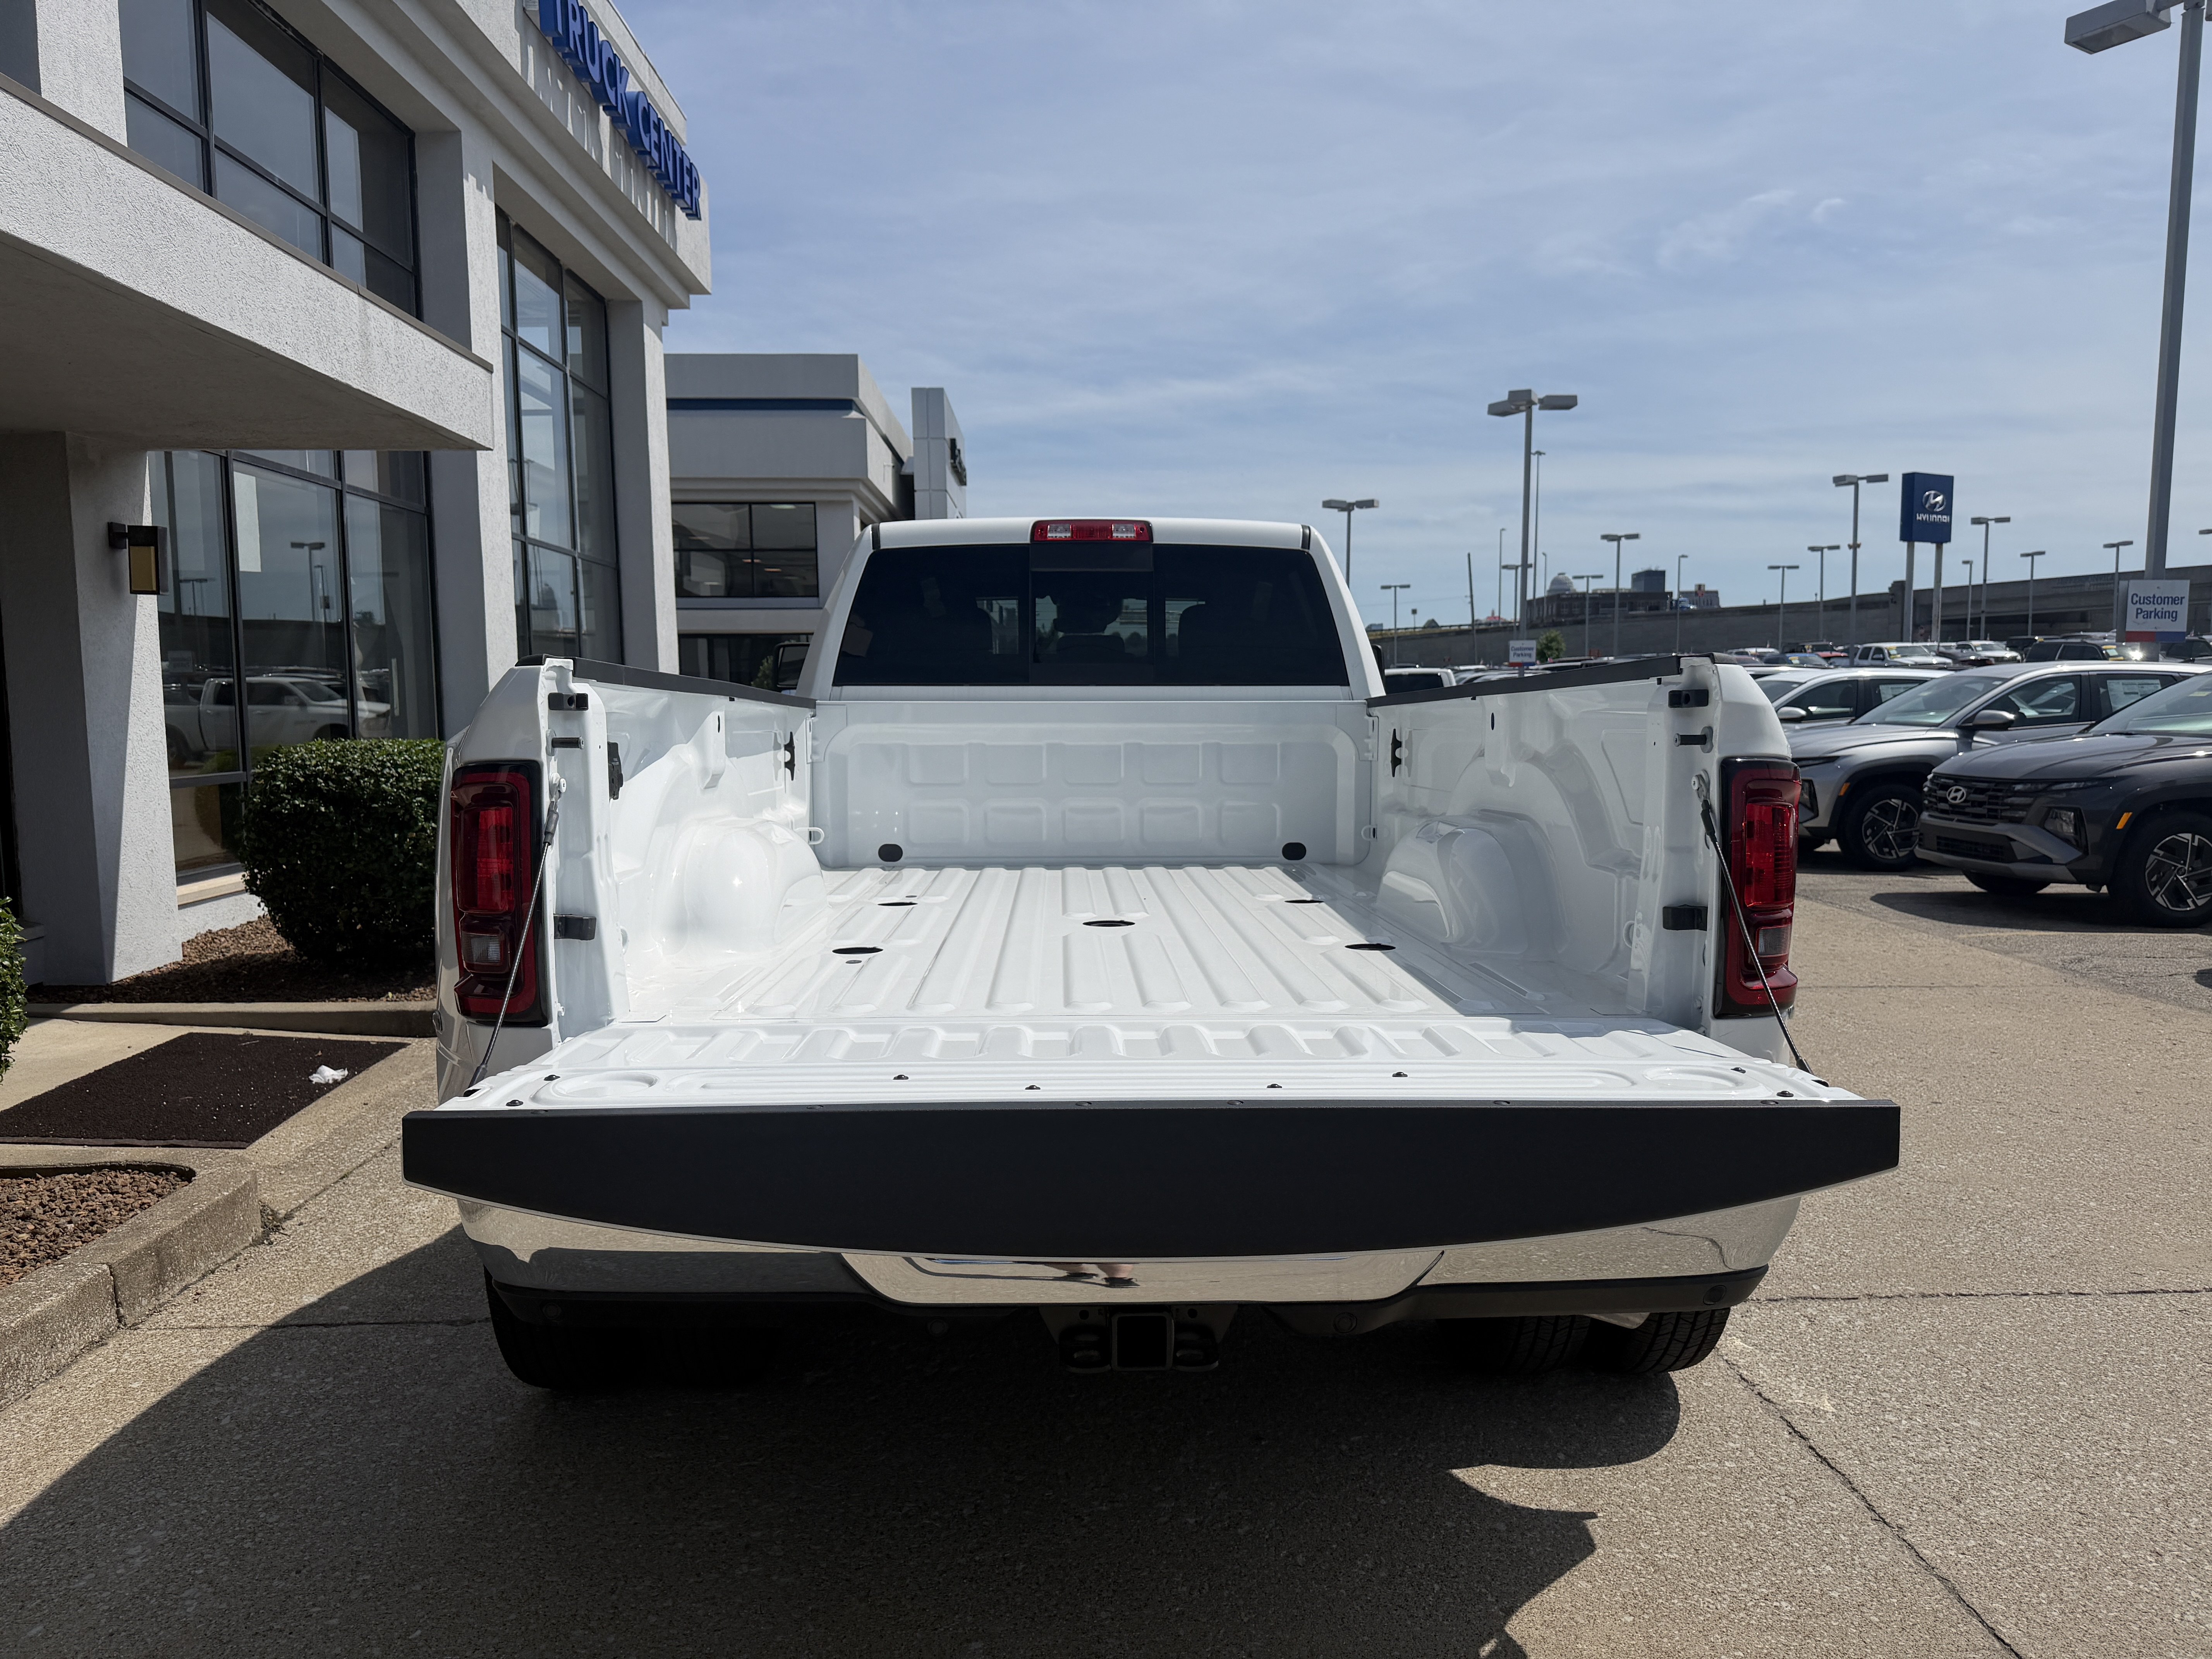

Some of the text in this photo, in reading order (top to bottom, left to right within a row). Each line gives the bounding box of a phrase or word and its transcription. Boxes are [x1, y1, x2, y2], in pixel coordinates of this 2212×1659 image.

[635, 91, 701, 220] CENTER
[1917, 514, 1949, 522] HYUNDAI
[2131, 593, 2185, 605] Customer
[2136, 608, 2178, 622] Parking
